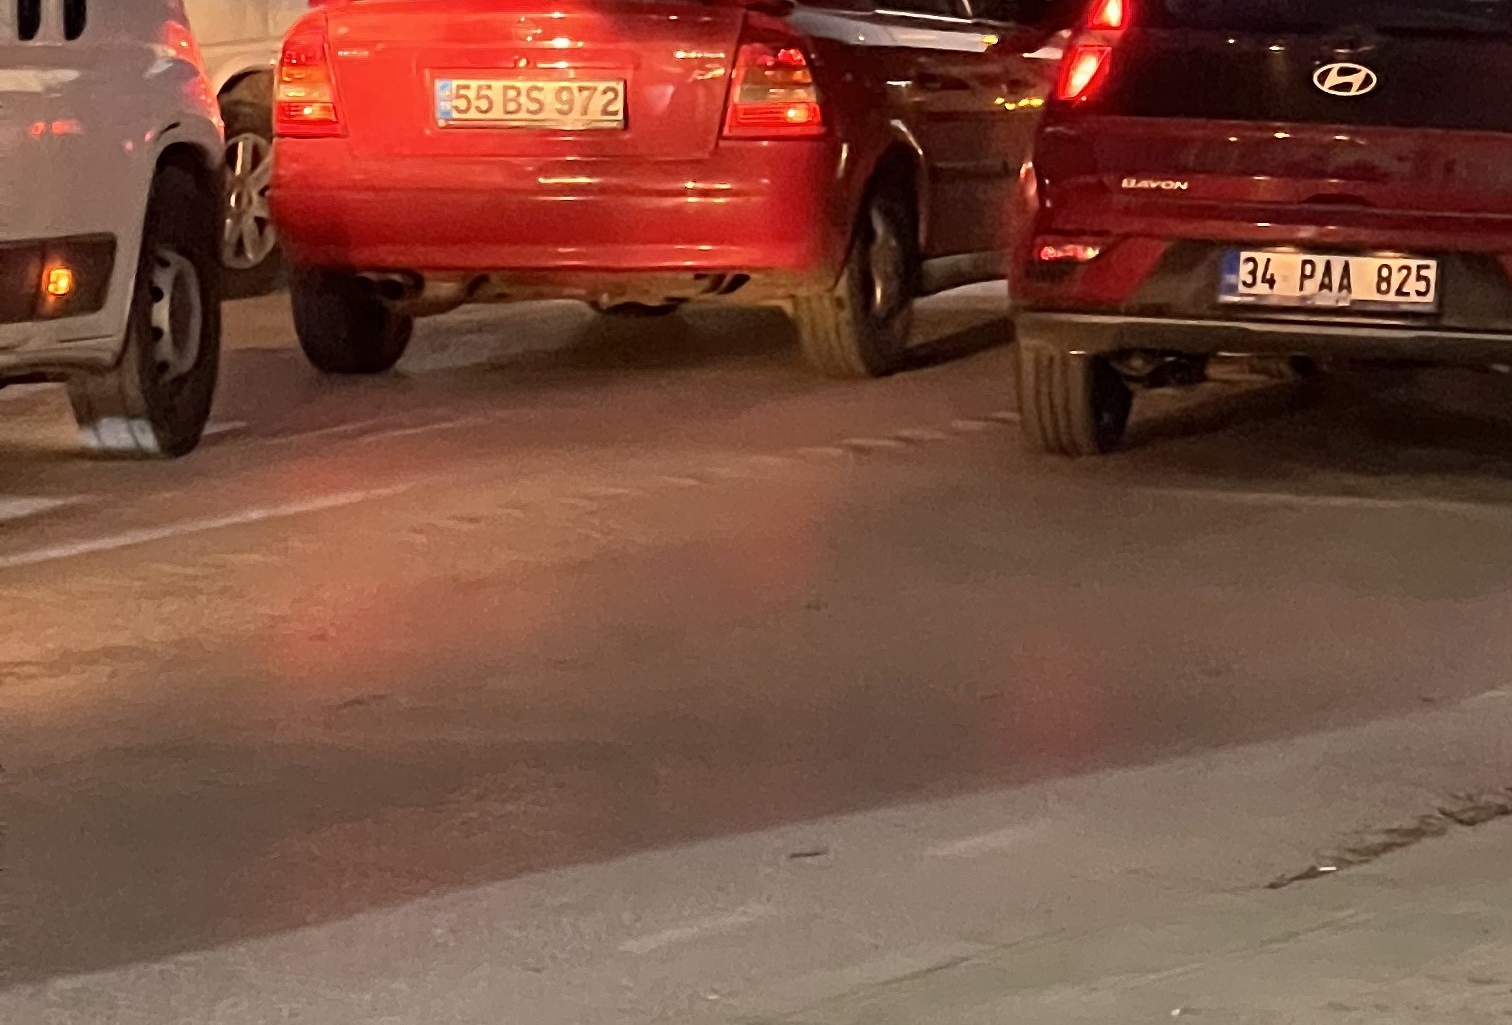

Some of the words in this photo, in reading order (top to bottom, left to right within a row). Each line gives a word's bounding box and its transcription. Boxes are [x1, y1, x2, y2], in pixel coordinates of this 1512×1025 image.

[453, 83, 494, 115] 55
[502, 84, 545, 116] BS
[554, 85, 620, 117] 972
[1241, 255, 1277, 291] 34
[1298, 258, 1353, 294] PAA
[1375, 262, 1432, 298] 825
